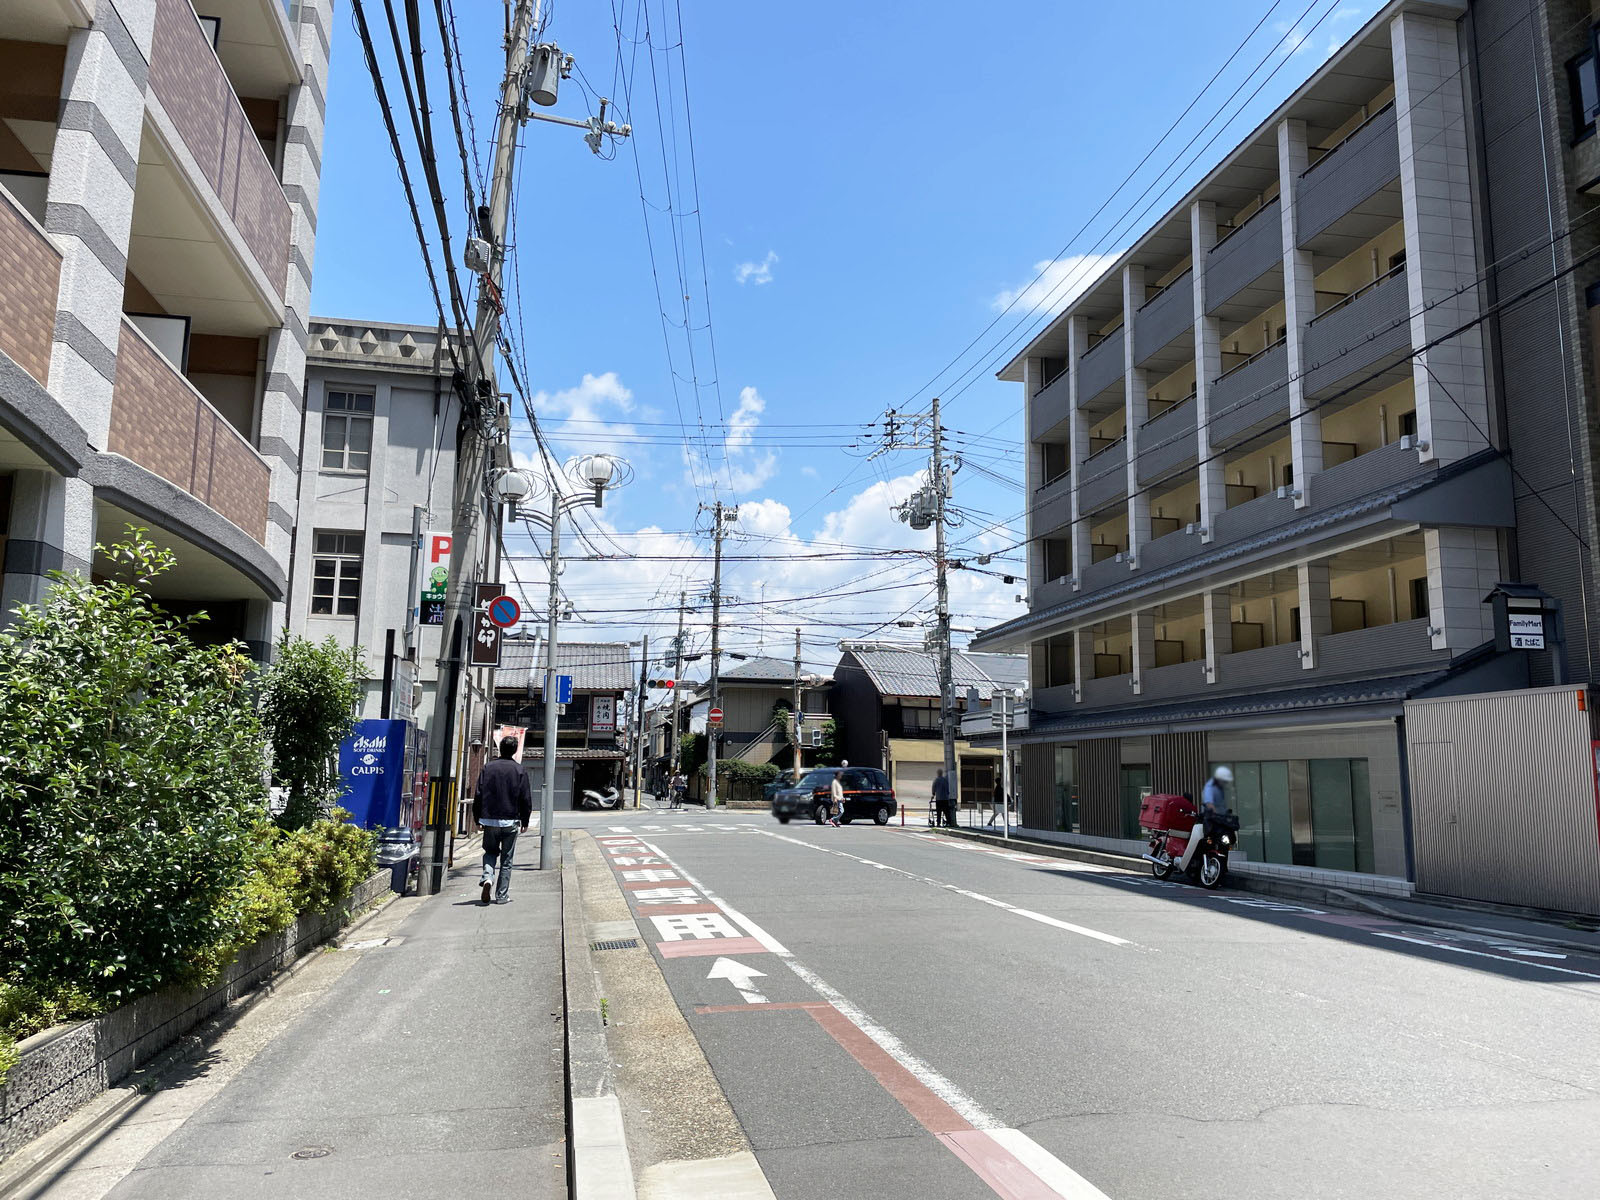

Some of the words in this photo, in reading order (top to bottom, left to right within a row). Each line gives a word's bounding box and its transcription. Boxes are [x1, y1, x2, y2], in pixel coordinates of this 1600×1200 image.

[431, 536, 452, 563] P
[1524, 638, 1540, 646] たばこ
[353, 735, 387, 749] Asahi
[351, 766, 385, 776] CALPIS
